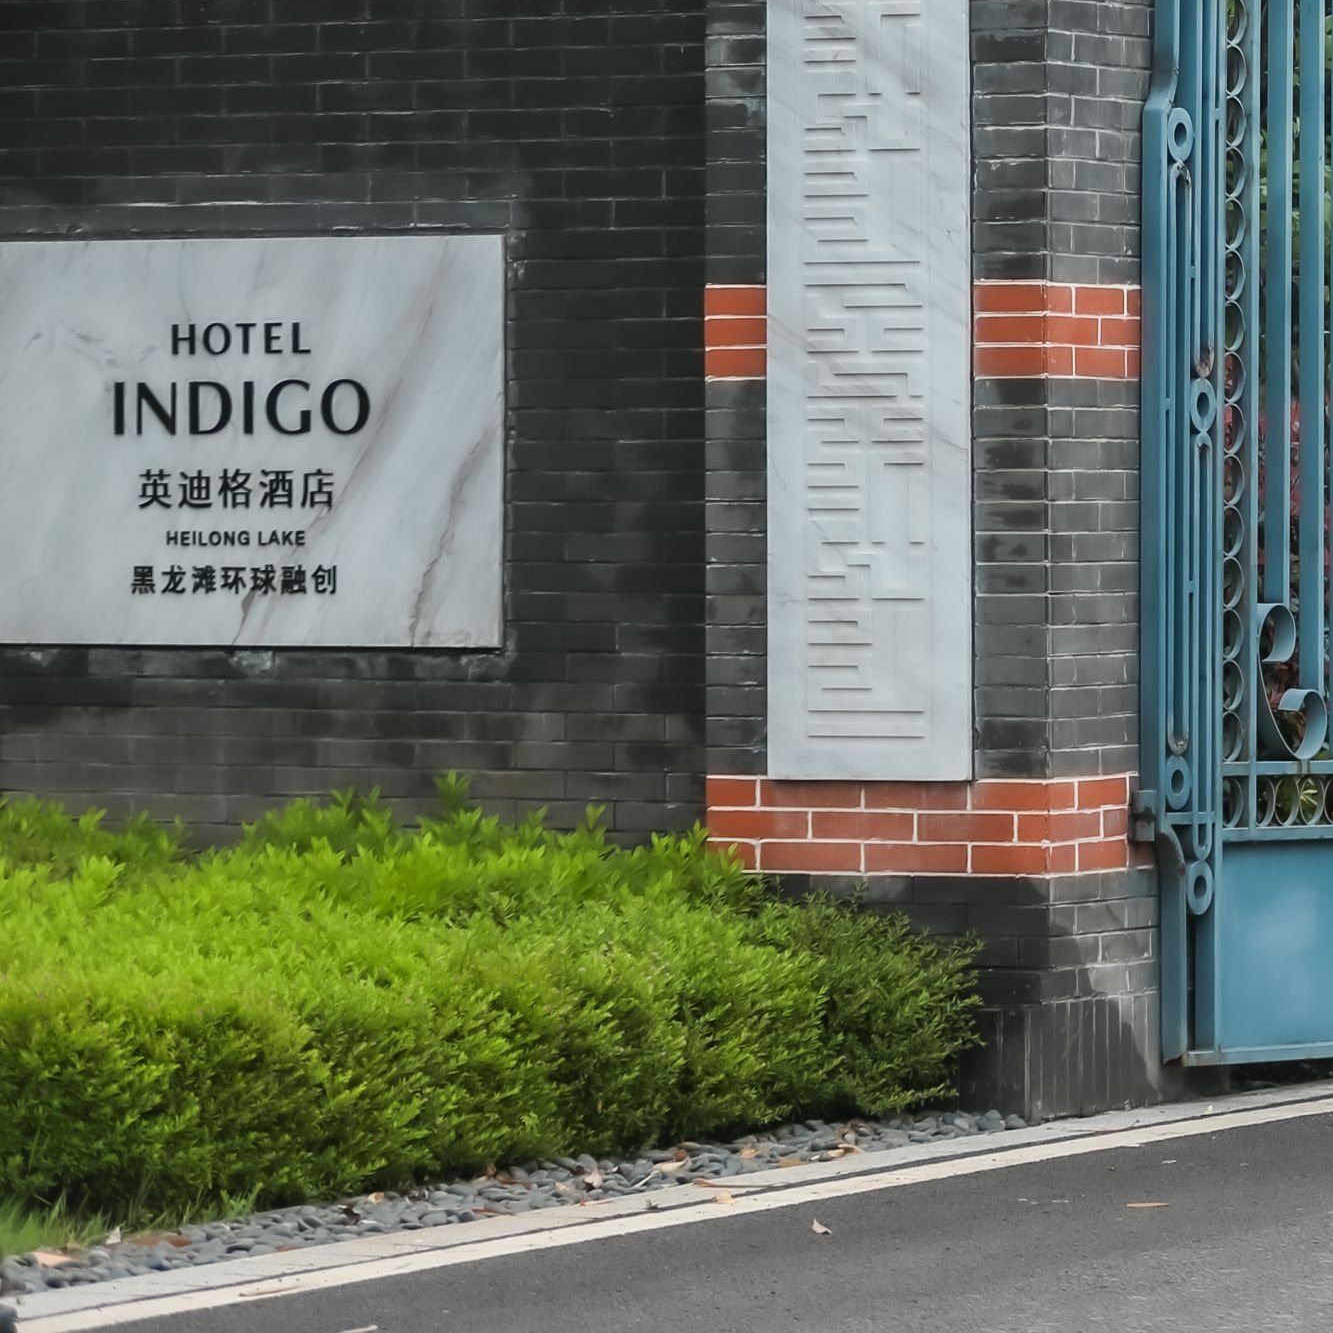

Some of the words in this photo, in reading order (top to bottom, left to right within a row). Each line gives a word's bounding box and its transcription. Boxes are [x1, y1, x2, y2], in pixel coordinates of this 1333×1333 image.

[170, 321, 312, 356] HOTEL
[111, 378, 371, 436] INDIGO
[138, 468, 335, 509] 英迪格酒店
[166, 530, 251, 546] HEILONG
[257, 530, 306, 546] LAKE
[131, 564, 338, 595] 黑龙滩环球融创
